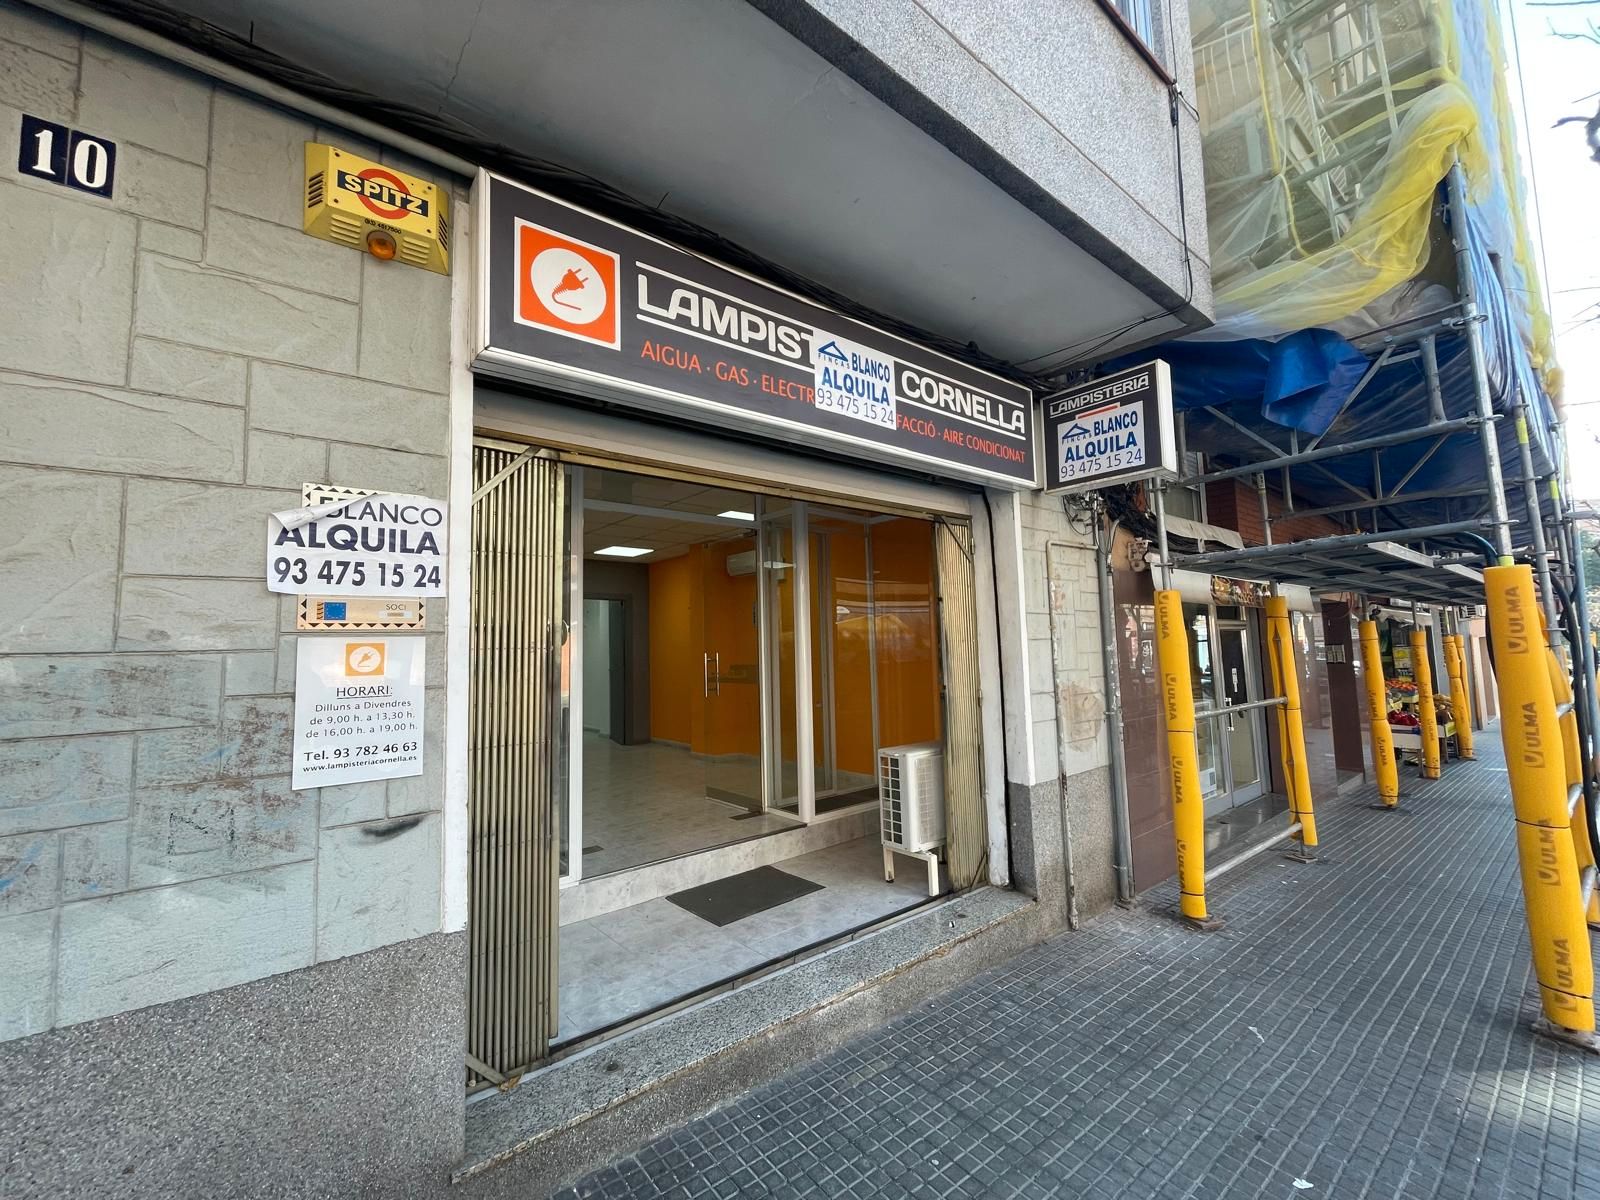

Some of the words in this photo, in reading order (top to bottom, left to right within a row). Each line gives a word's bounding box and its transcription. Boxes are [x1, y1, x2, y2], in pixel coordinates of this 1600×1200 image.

[32, 129, 108, 188] 10
[344, 174, 423, 214] SPITZ
[818, 353, 850, 369] FINCAS
[851, 352, 891, 383] BLANCO
[641, 340, 702, 374] AIGUA
[715, 361, 749, 386] GAS
[761, 374, 815, 404] ELECTR
[896, 413, 936, 438] FACCIÓ
[943, 428, 964, 446] AIRE
[966, 434, 1026, 464] CONDICIONAT
[821, 366, 890, 406] ALQUILA
[901, 370, 1025, 434] CORNELLA
[1050, 374, 1149, 415] LAMPISTERIA
[817, 388, 833, 407] 93
[837, 395, 860, 415] 475
[863, 402, 877, 420] 15
[881, 407, 895, 425] 24
[1093, 410, 1138, 437] BLANCO
[1061, 464, 1075, 479] 93
[1079, 457, 1102, 473] 475
[1106, 453, 1121, 469] 15
[1126, 448, 1143, 464] 24
[1064, 431, 1138, 463] ALQUILA
[274, 522, 441, 556] ALQUILA
[274, 556, 308, 585] 93
[317, 560, 366, 587] 475
[378, 562, 405, 588] 15
[413, 563, 441, 588] 24
[1159, 605, 1170, 640] ULMA
[1505, 585, 1526, 633] ULMA
[315, 704, 351, 713] Dilluns
[363, 699, 412, 710] Divendres
[336, 685, 393, 698] HORARI:
[1167, 687, 1177, 721] ULMA
[305, 730, 319, 738] de
[356, 726, 366, 734] h.
[379, 723, 406, 732] 19,00
[409, 722, 418, 730] h.
[309, 717, 323, 725] de
[353, 714, 363, 722] h.
[376, 711, 403, 720] 13,30
[406, 710, 415, 719] h.
[1522, 701, 1541, 748] ULMA
[303, 755, 417, 772] www.lampisteriacornella.es
[304, 750, 329, 762] Tel.
[333, 748, 350, 759] 93
[355, 745, 379, 757] 782
[382, 743, 399, 753] 46
[402, 741, 418, 751] 63
[1173, 772, 1183, 804] ULMA
[1553, 938, 1575, 990] ULMA
